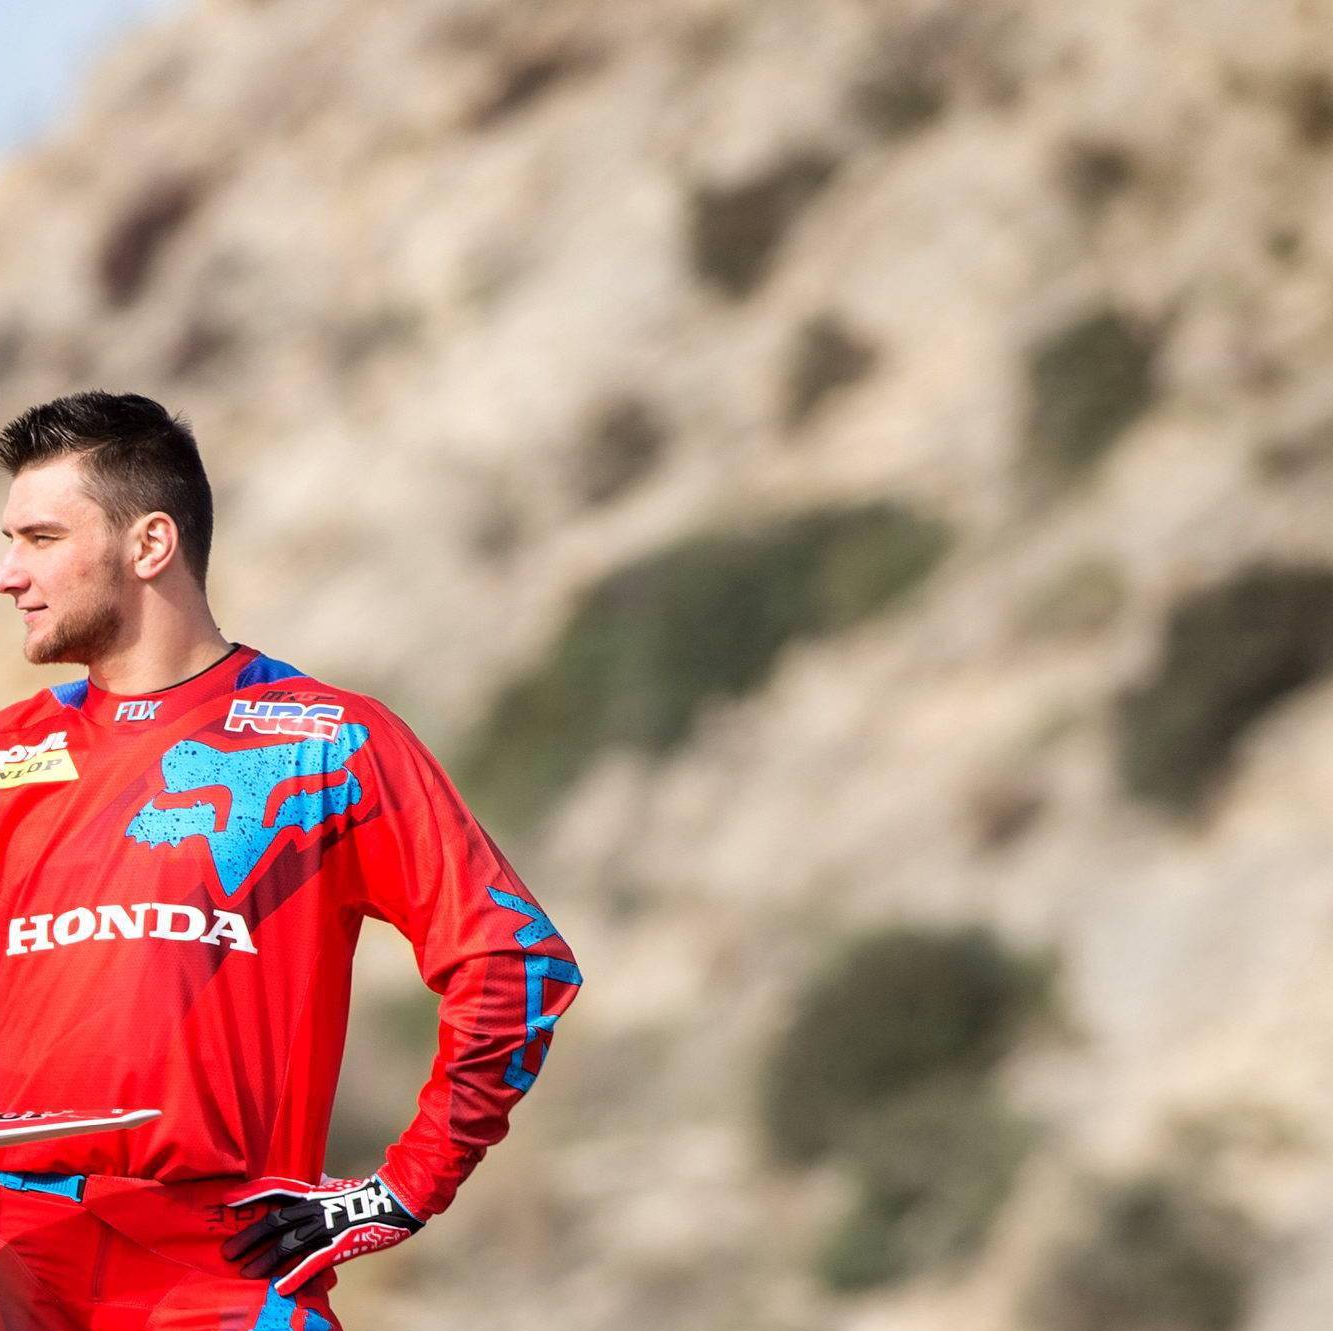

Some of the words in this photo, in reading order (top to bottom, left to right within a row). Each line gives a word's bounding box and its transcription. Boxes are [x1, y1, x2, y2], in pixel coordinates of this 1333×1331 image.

[113, 700, 164, 722] FOX
[224, 699, 344, 743] HRC
[6, 902, 258, 957] HONDA
[320, 1185, 392, 1229] FOX
